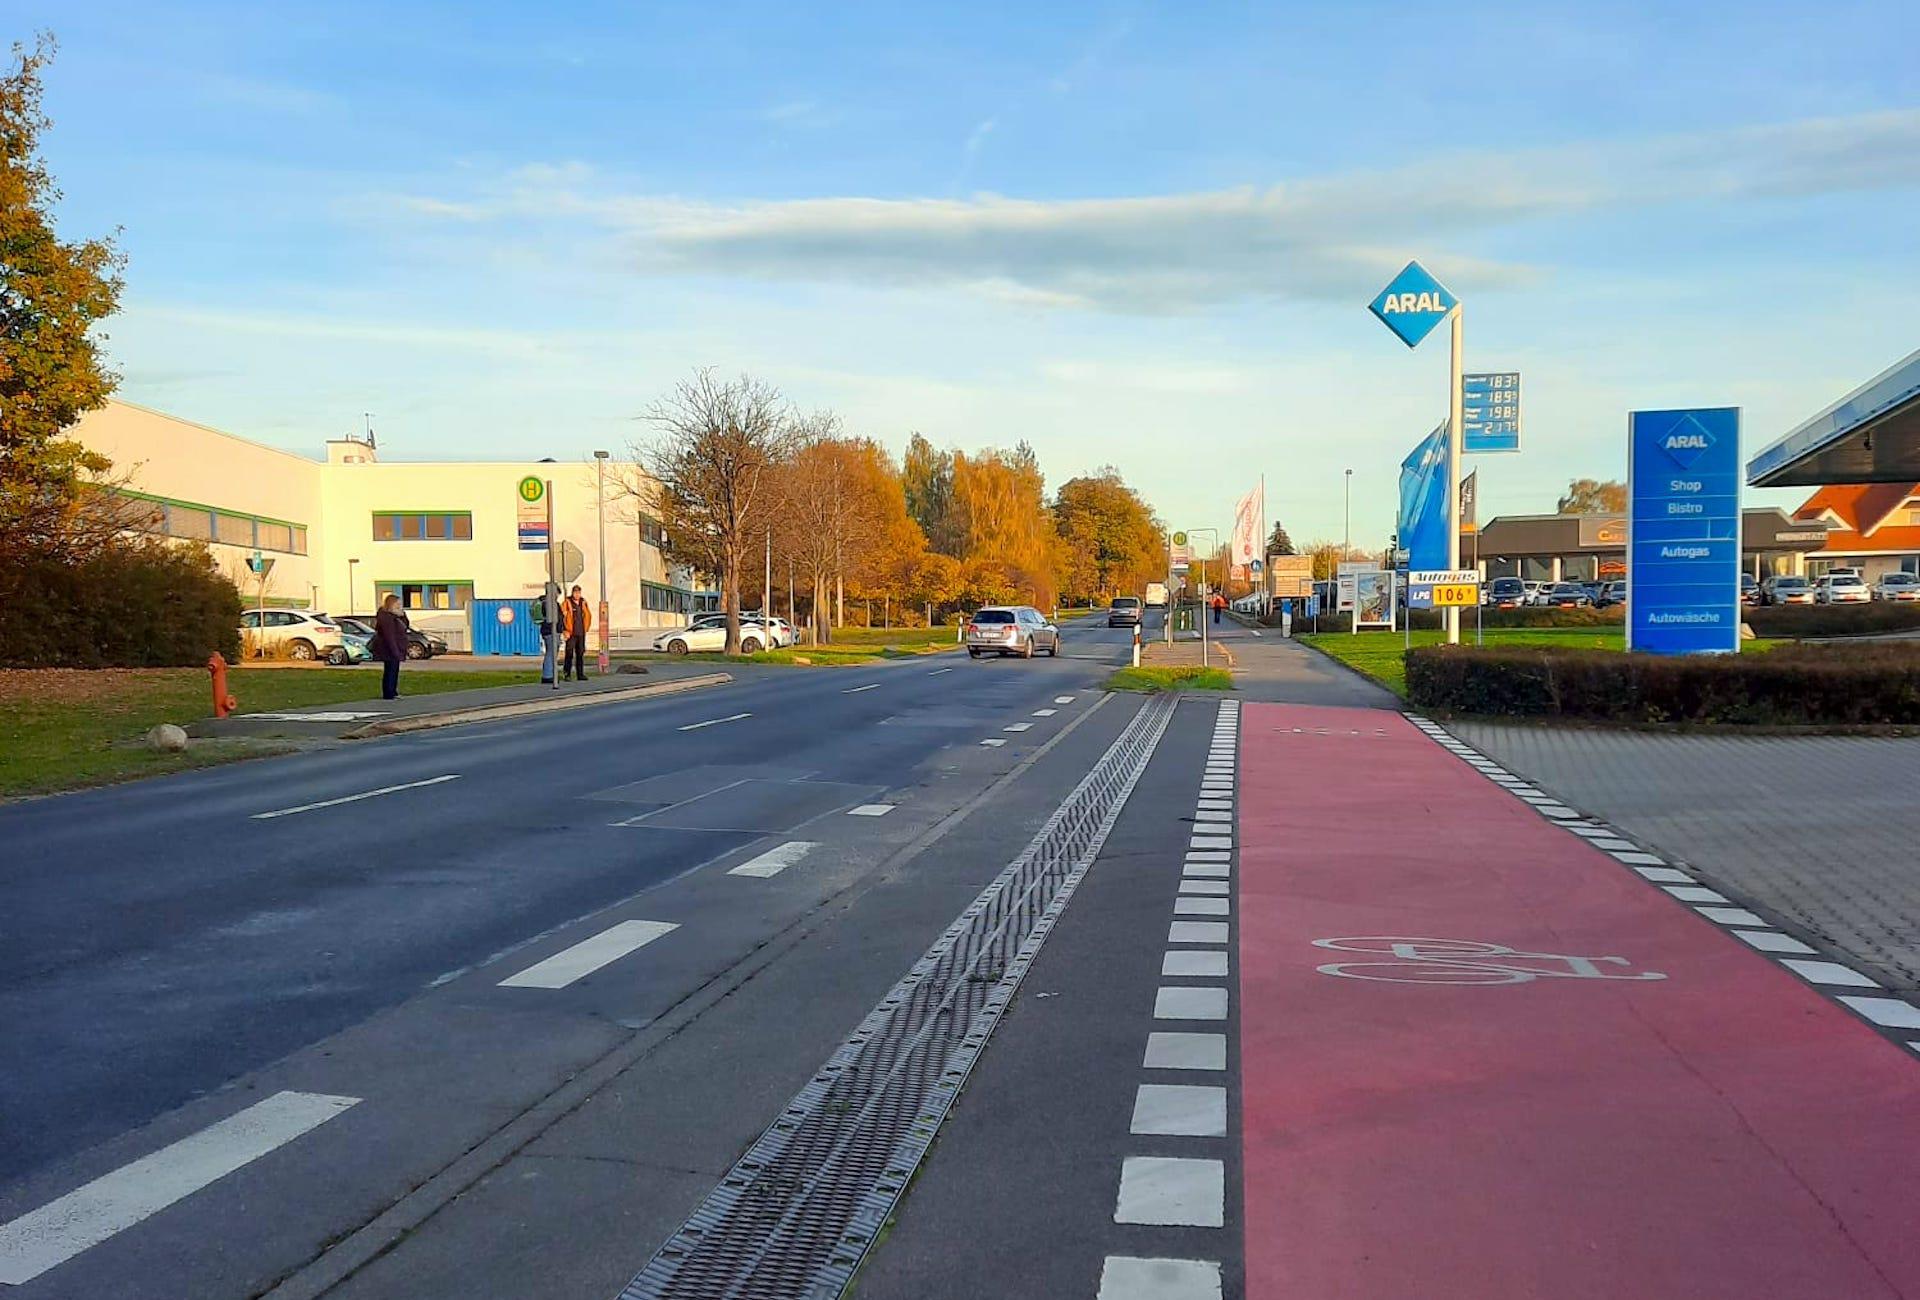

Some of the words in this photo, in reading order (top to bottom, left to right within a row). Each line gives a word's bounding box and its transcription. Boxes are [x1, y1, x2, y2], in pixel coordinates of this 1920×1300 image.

[1383, 292, 1447, 314] ARAL
[1666, 435, 1708, 449] ARAL
[1670, 480, 1702, 493] Shop
[1667, 502, 1703, 514] Bistro
[1660, 546, 1710, 558] Autogas
[1415, 572, 1475, 582] Autogas
[1648, 611, 1720, 624] Autowäsche
